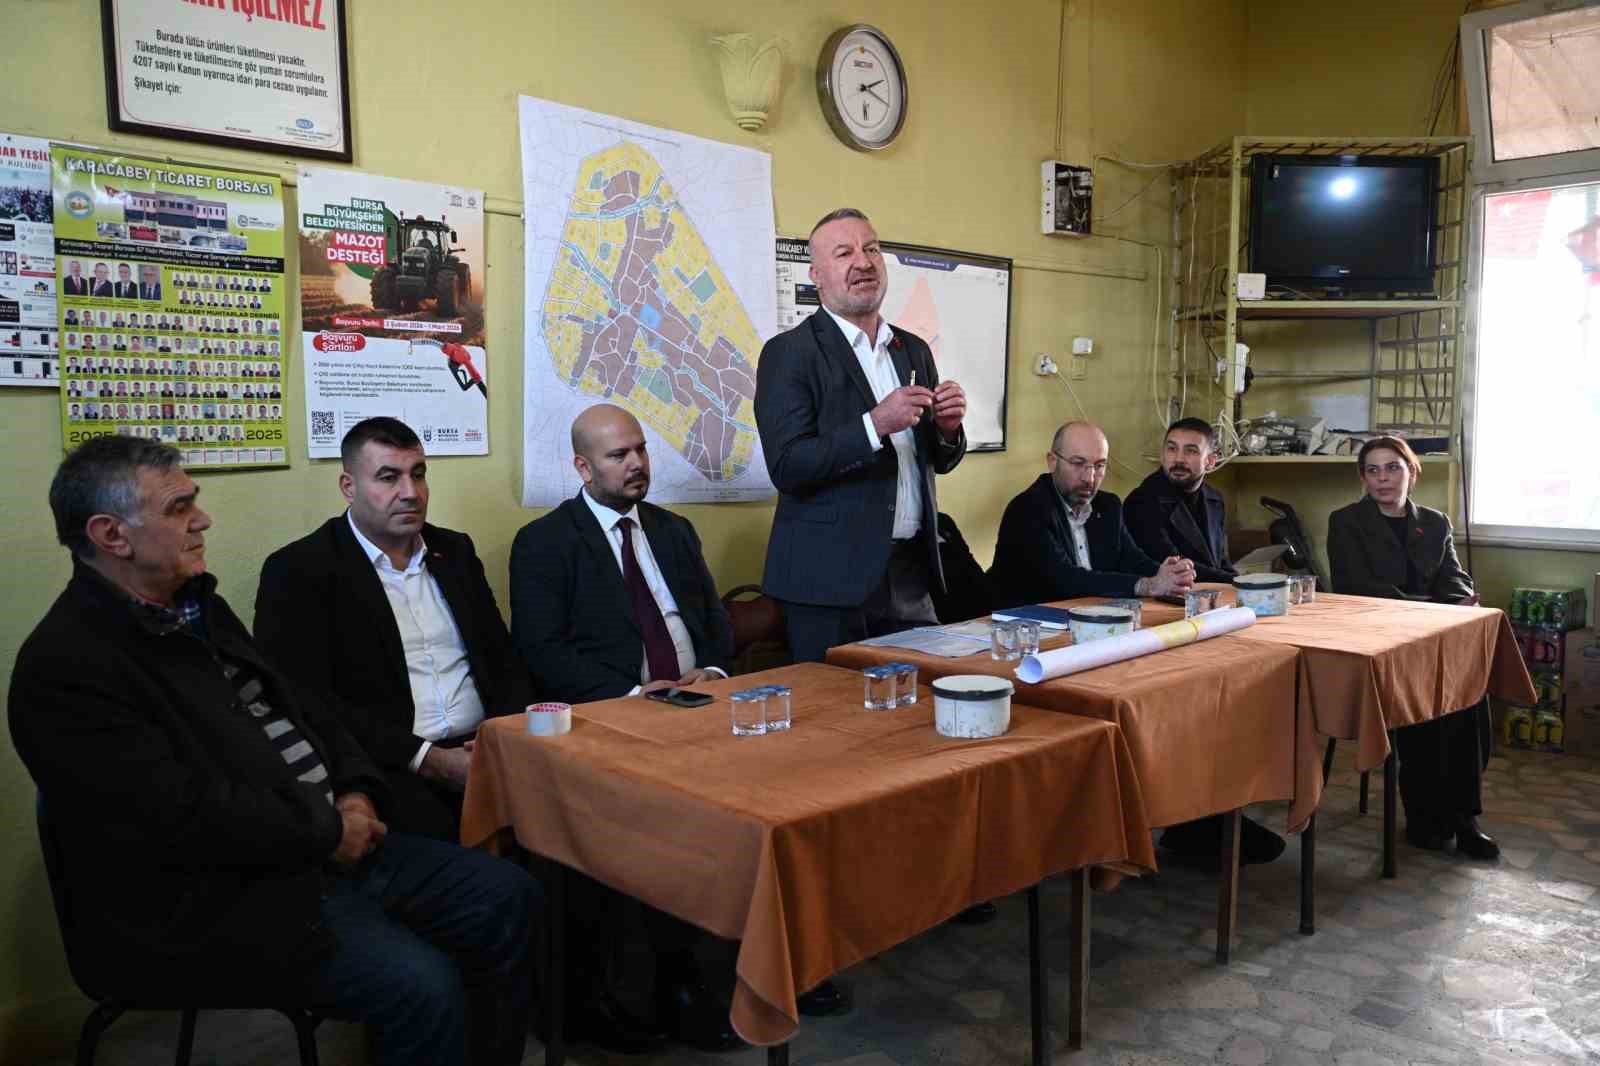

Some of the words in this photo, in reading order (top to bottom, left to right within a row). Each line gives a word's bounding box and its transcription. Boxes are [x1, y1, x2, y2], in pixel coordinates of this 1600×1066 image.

[231, 0, 326, 30] LMEZ
[156, 29, 184, 45] Burada
[185, 35, 205, 49] tütün
[206, 40, 236, 54] ürünleri
[237, 45, 276, 62] tüketilmesi
[277, 55, 306, 68] yasaktır.
[136, 39, 181, 59] Tüketenlere
[183, 51, 193, 61] ve
[194, 51, 243, 70] tüketilmesine
[244, 63, 257, 74] göz
[258, 65, 283, 77] yuman
[284, 69, 325, 84] sorumlulara
[132, 55, 152, 68] 4207
[154, 60, 175, 73] sayılı
[177, 63, 201, 77] Kanun
[203, 69, 235, 83] uyarınca
[254, 78, 271, 89] para
[272, 81, 295, 93] cezası
[296, 85, 329, 99] uygulanır.
[134, 76, 163, 93] Şikayet
[165, 80, 183, 97] için:
[0, 146, 16, 157] AR
[65, 156, 151, 181] KARACABEY
[156, 170, 212, 189] TİCARET
[216, 179, 273, 197] BORSASI
[352, 199, 383, 210] BURSA
[326, 206, 384, 222] BÜYÜKŞEHİR
[305, 216, 384, 233] BELEDİYESİNDEN
[335, 232, 384, 249] MAZOT
[327, 247, 384, 265] DESTEĞİ
[321, 331, 357, 344] Başvuru
[246, 430, 283, 441] 2025
